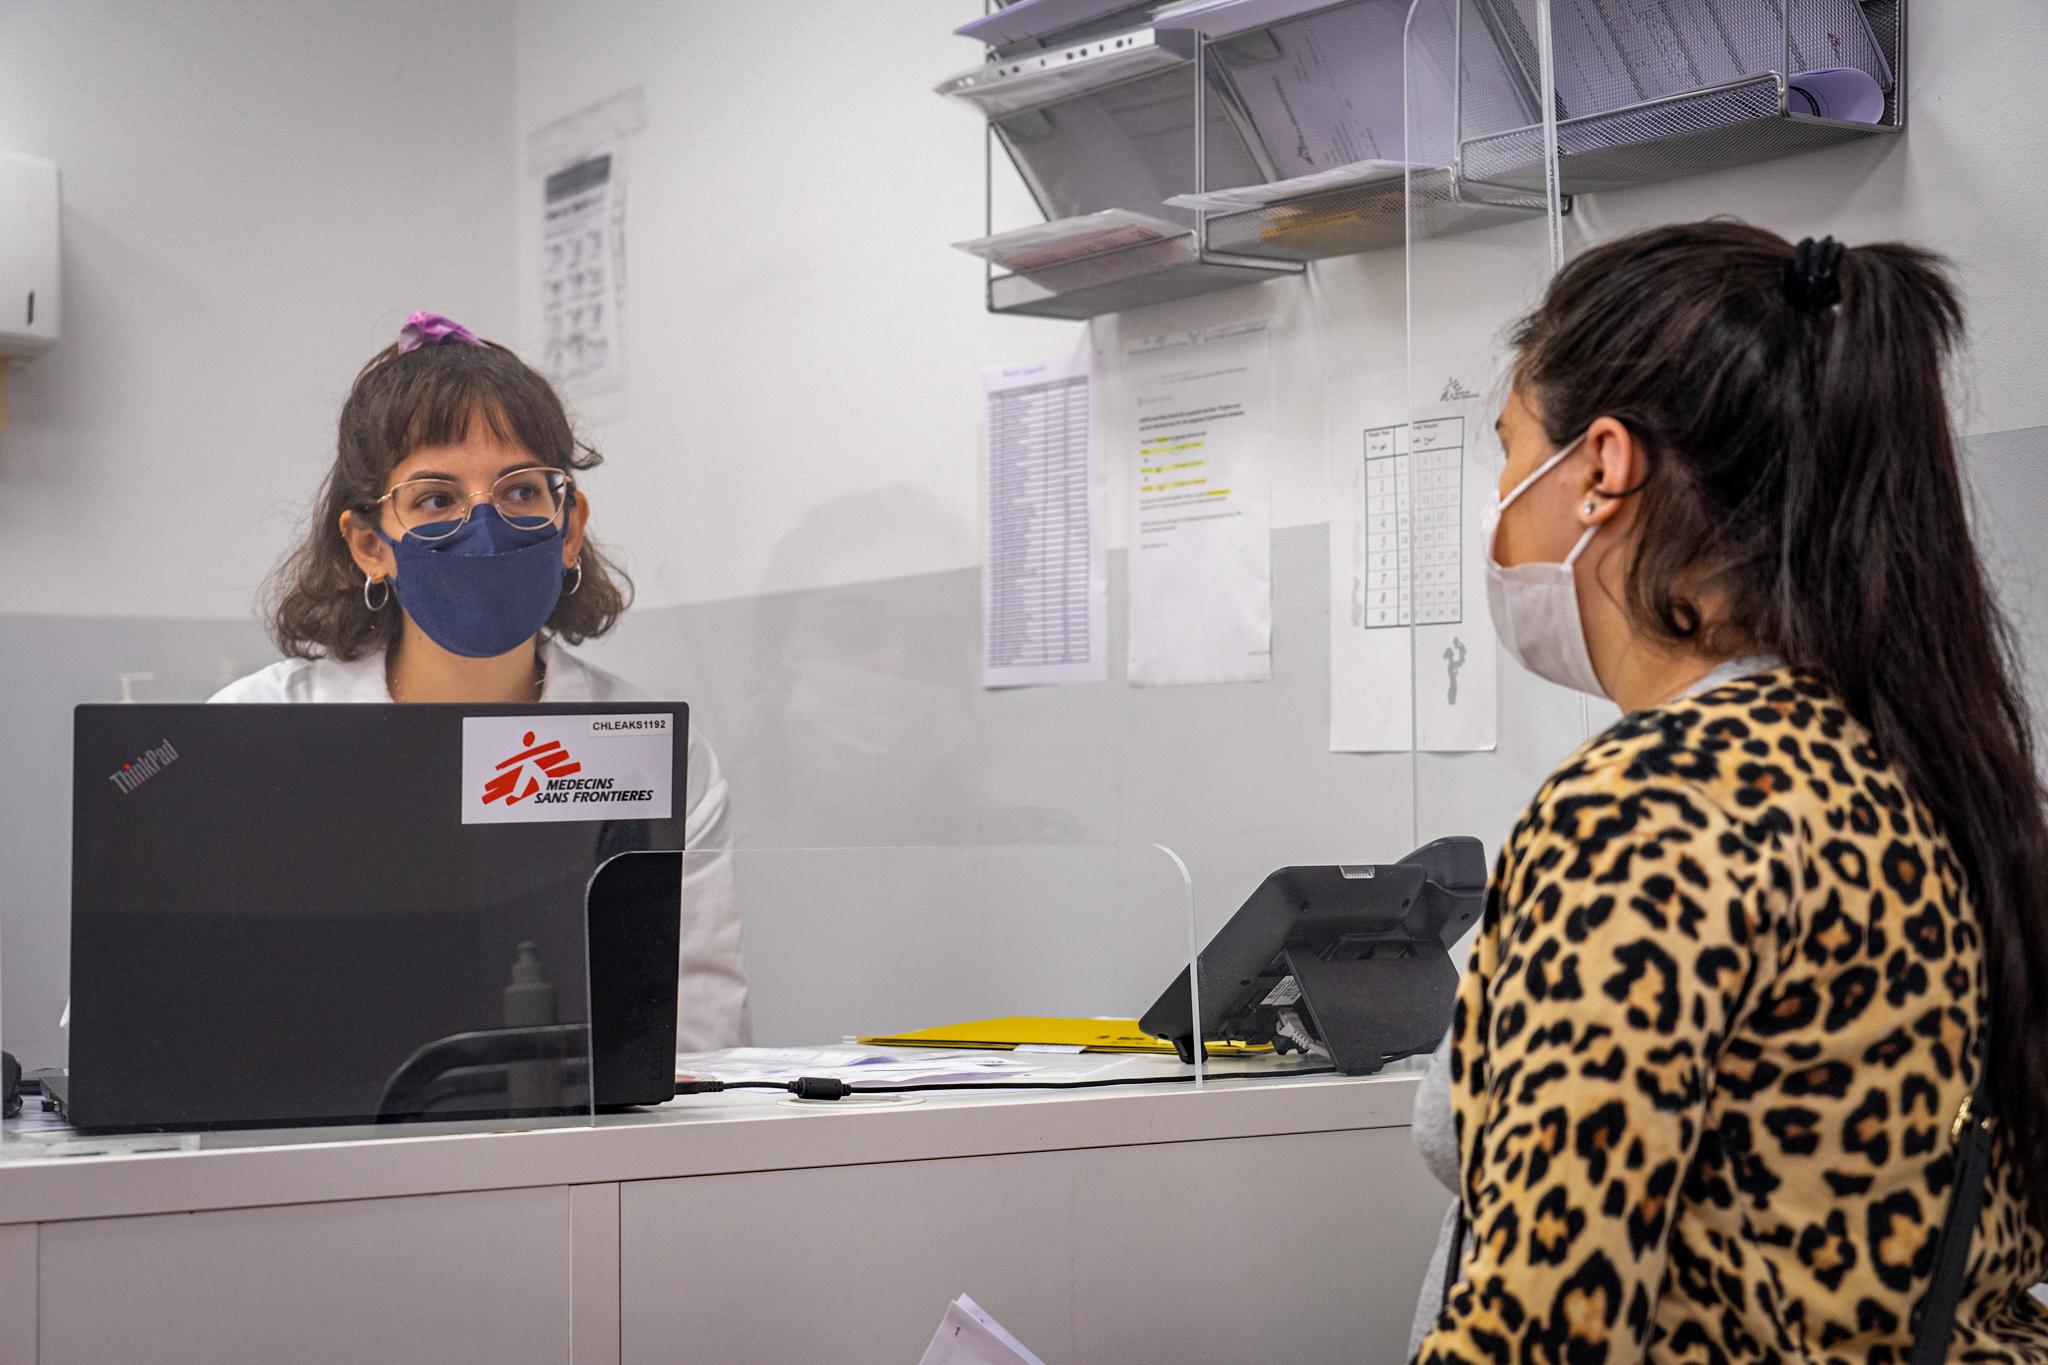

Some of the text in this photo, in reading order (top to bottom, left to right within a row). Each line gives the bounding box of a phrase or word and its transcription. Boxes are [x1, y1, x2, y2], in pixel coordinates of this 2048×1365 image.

[592, 720, 666, 731] CHLEAKS1192
[109, 738, 179, 794] ThinkPad
[546, 778, 614, 791] MEDECINS
[534, 790, 654, 804] SANS FRONTIERES
